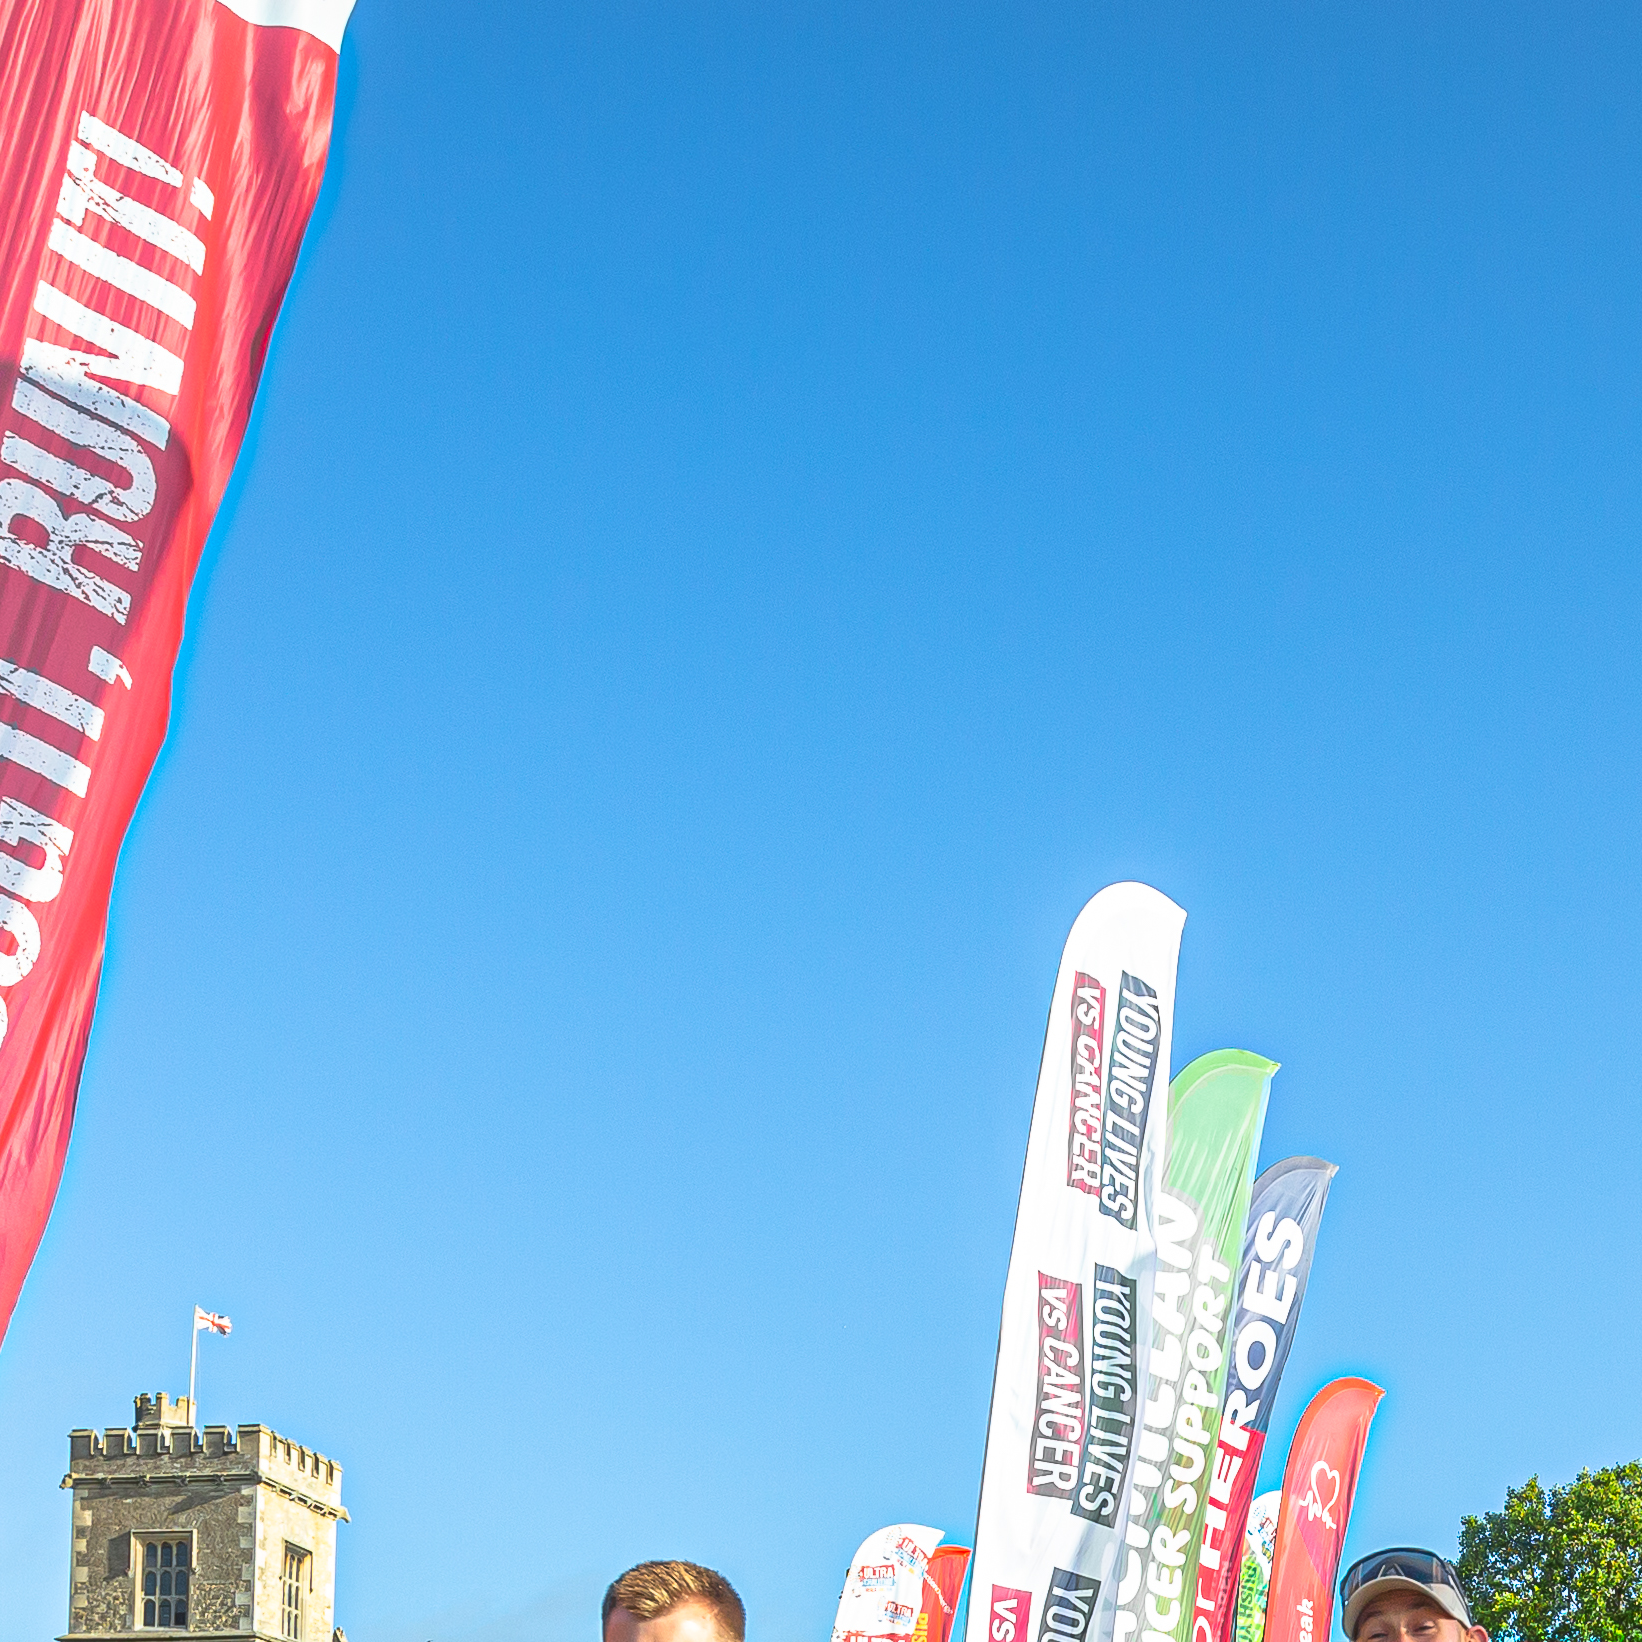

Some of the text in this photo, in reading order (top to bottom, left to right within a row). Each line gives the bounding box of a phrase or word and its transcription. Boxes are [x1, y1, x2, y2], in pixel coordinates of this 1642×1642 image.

[46, 109, 216, 330] IT!
[1072, 986, 1103, 1190] VS CANCER
[1100, 986, 1159, 1222] YOUNG LIVES
[1032, 1286, 1082, 1493] VS CANCER
[1078, 1277, 1133, 1519] YOUNG LIVES
[1164, 1243, 1231, 1515] SUPPORT
[1198, 1210, 1305, 1571] HEROES
[863, 1566, 895, 1579] ULTRA
